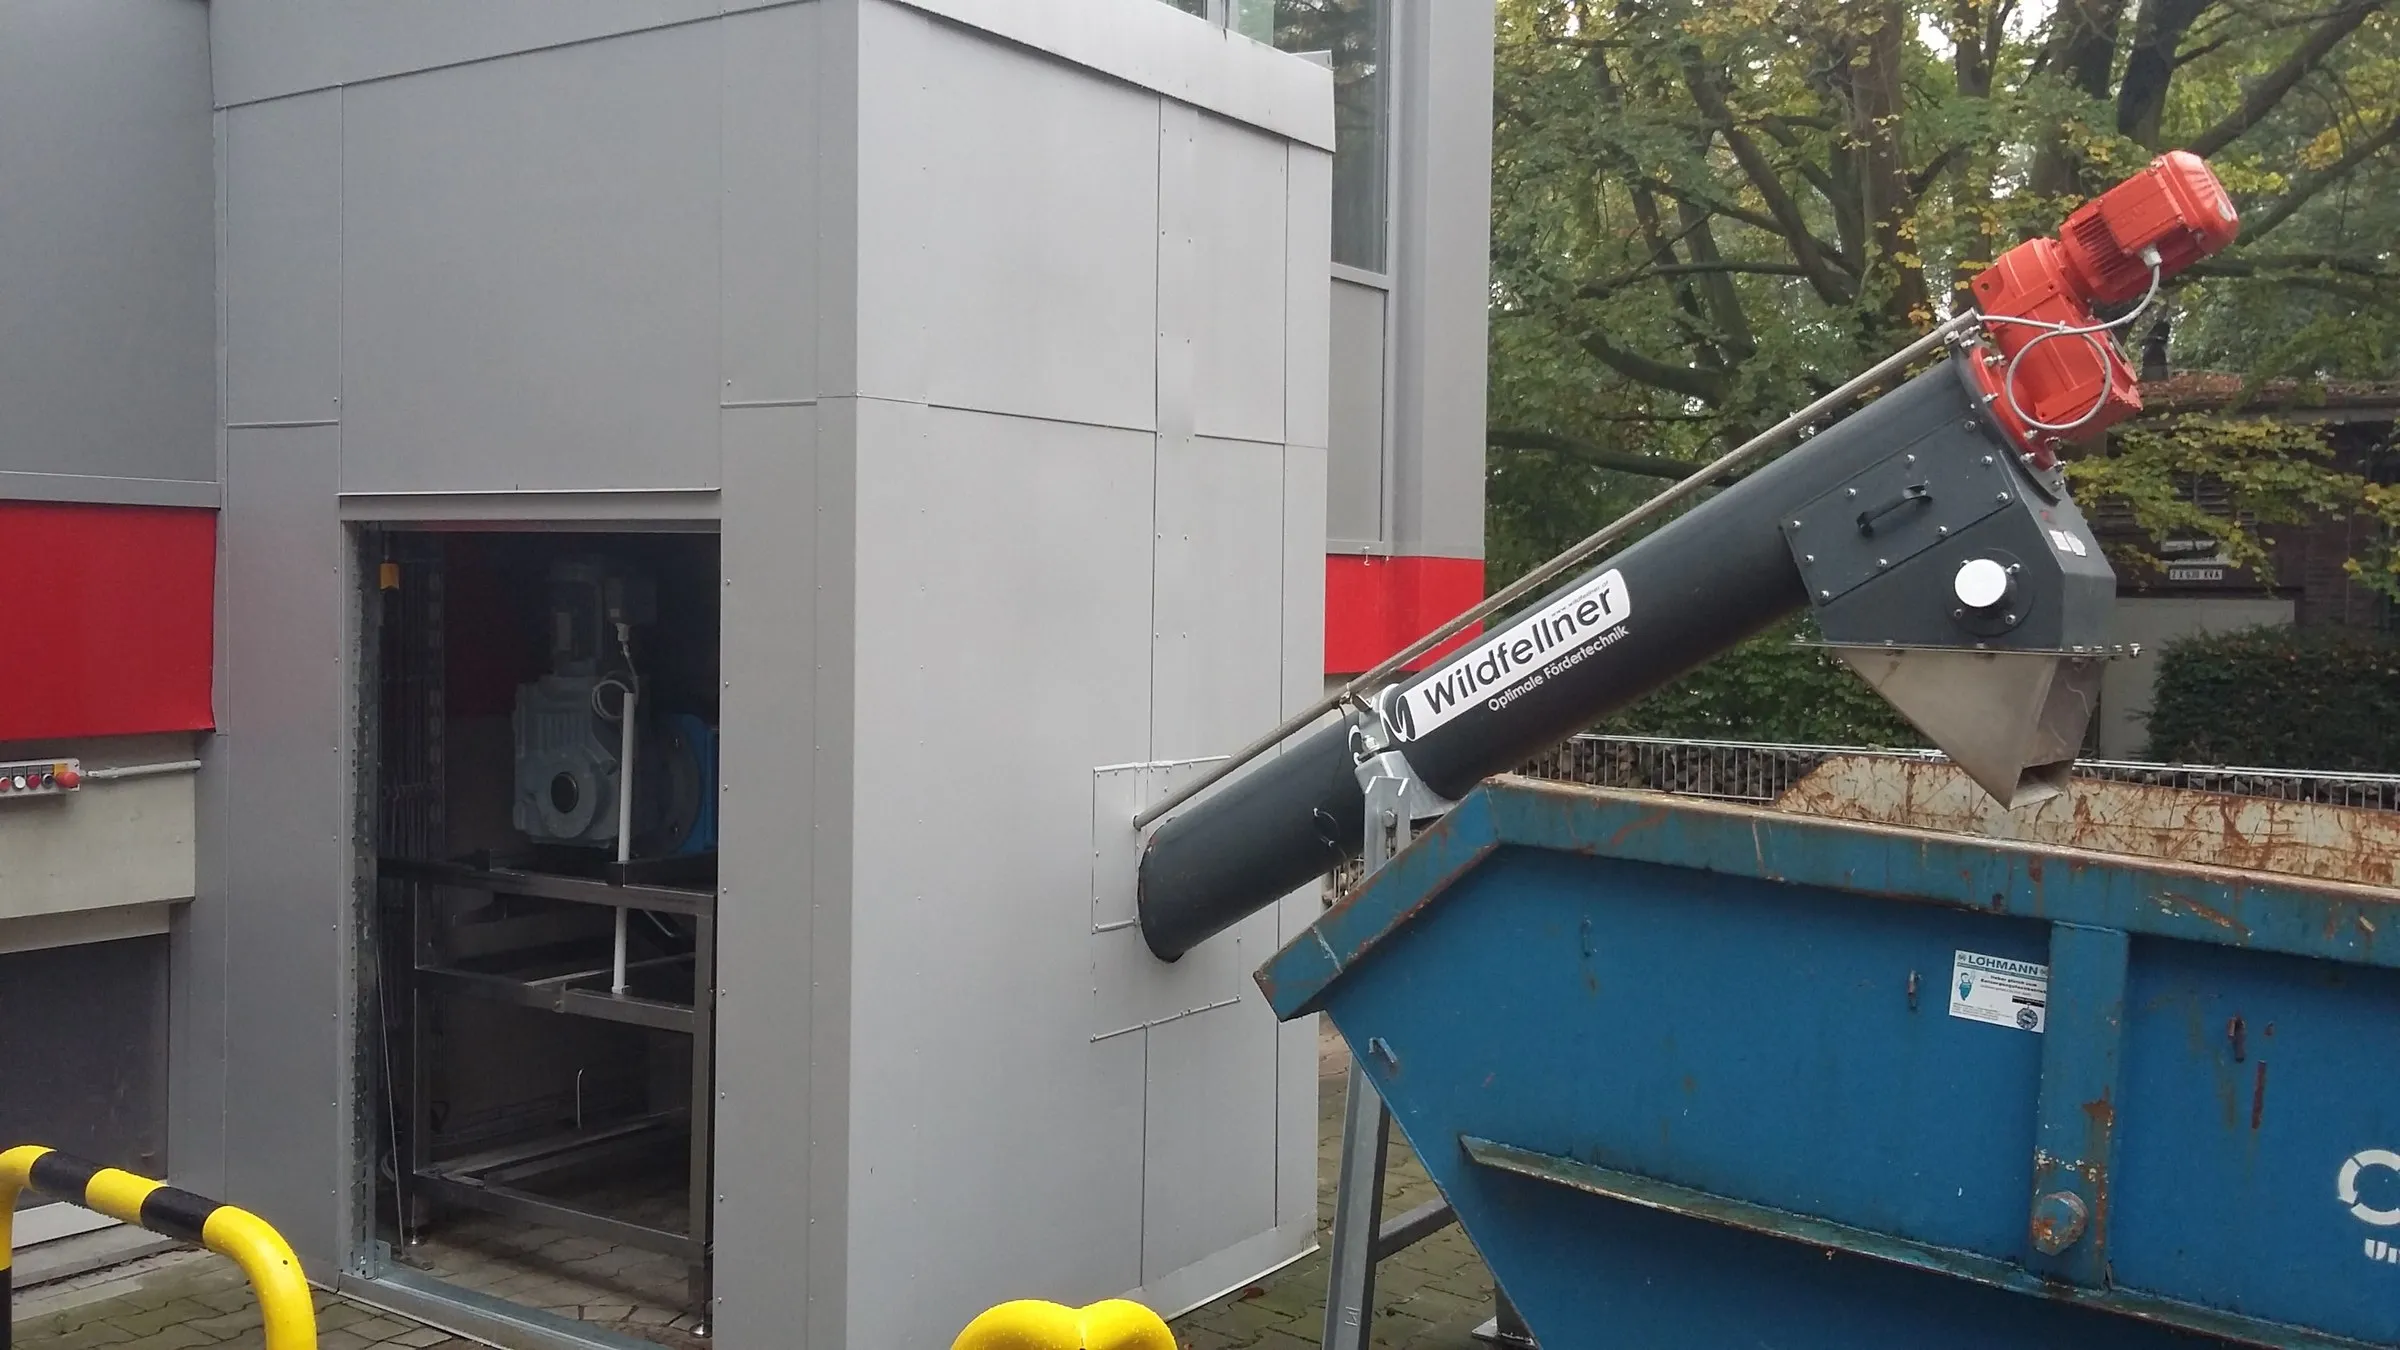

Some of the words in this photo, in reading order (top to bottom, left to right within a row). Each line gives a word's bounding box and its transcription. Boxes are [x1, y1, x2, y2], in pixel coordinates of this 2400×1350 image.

[1423, 587, 1612, 715] Wildfellner
[1488, 673, 1544, 712] Optimale
[1545, 624, 1630, 680] Fördertechnik
[1968, 955, 2039, 975] LOHMANN
